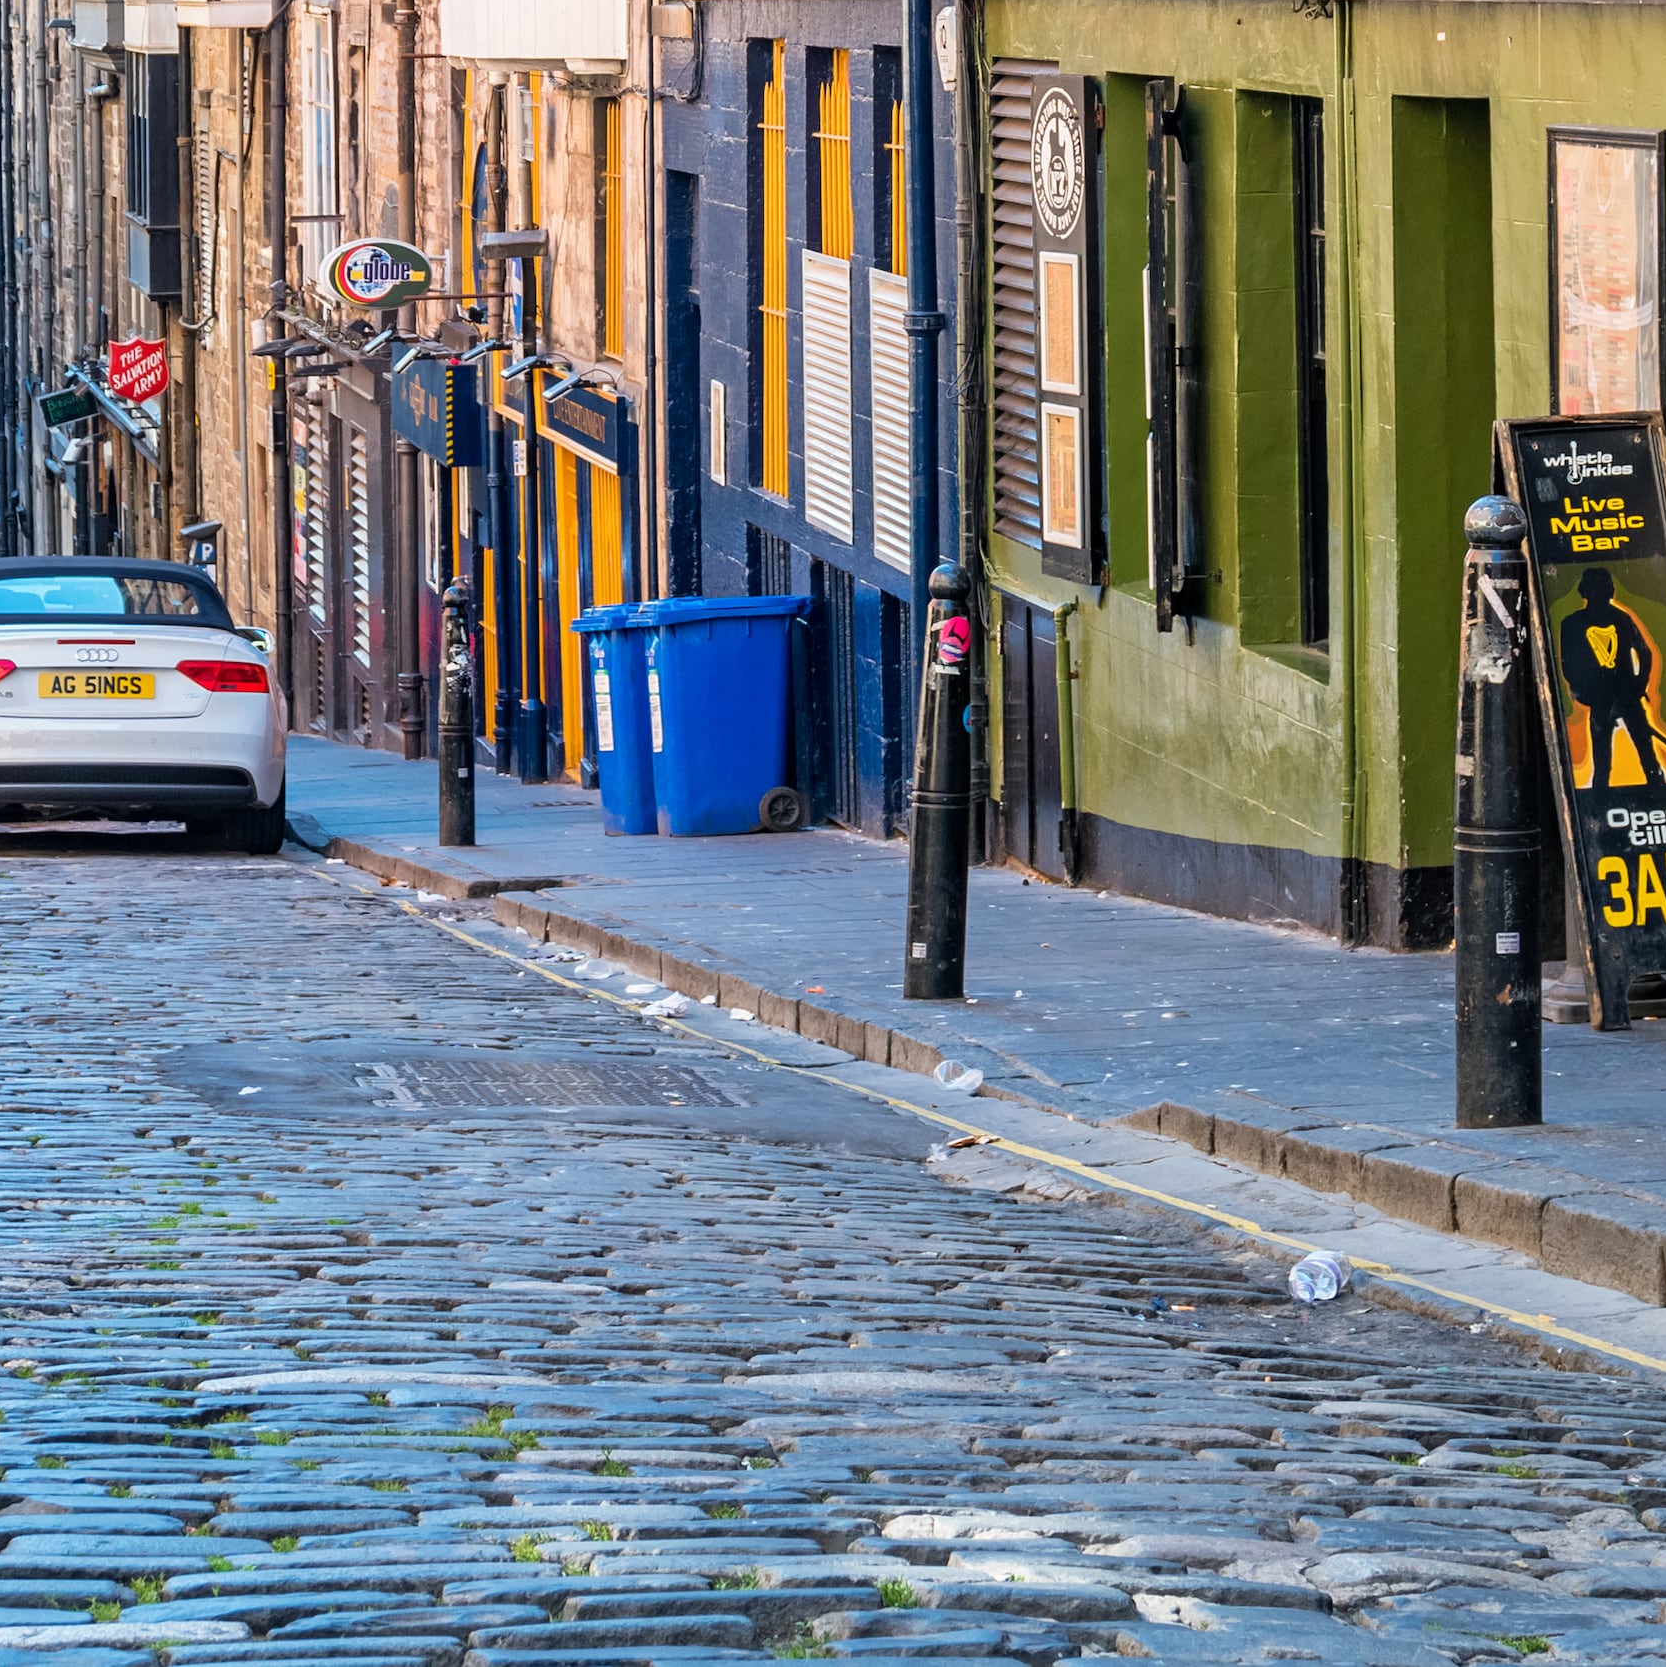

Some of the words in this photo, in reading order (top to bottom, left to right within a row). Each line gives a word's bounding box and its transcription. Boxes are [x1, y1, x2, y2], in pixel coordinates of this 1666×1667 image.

[364, 258, 411, 283] globe
[119, 345, 143, 368] THE
[112, 347, 163, 390] SALVATION
[133, 365, 163, 397] ARMY
[1564, 496, 1625, 514] Live
[1550, 513, 1645, 534] Music
[202, 543, 213, 561] P
[1571, 534, 1630, 552] Bar
[51, 676, 76, 694] AG
